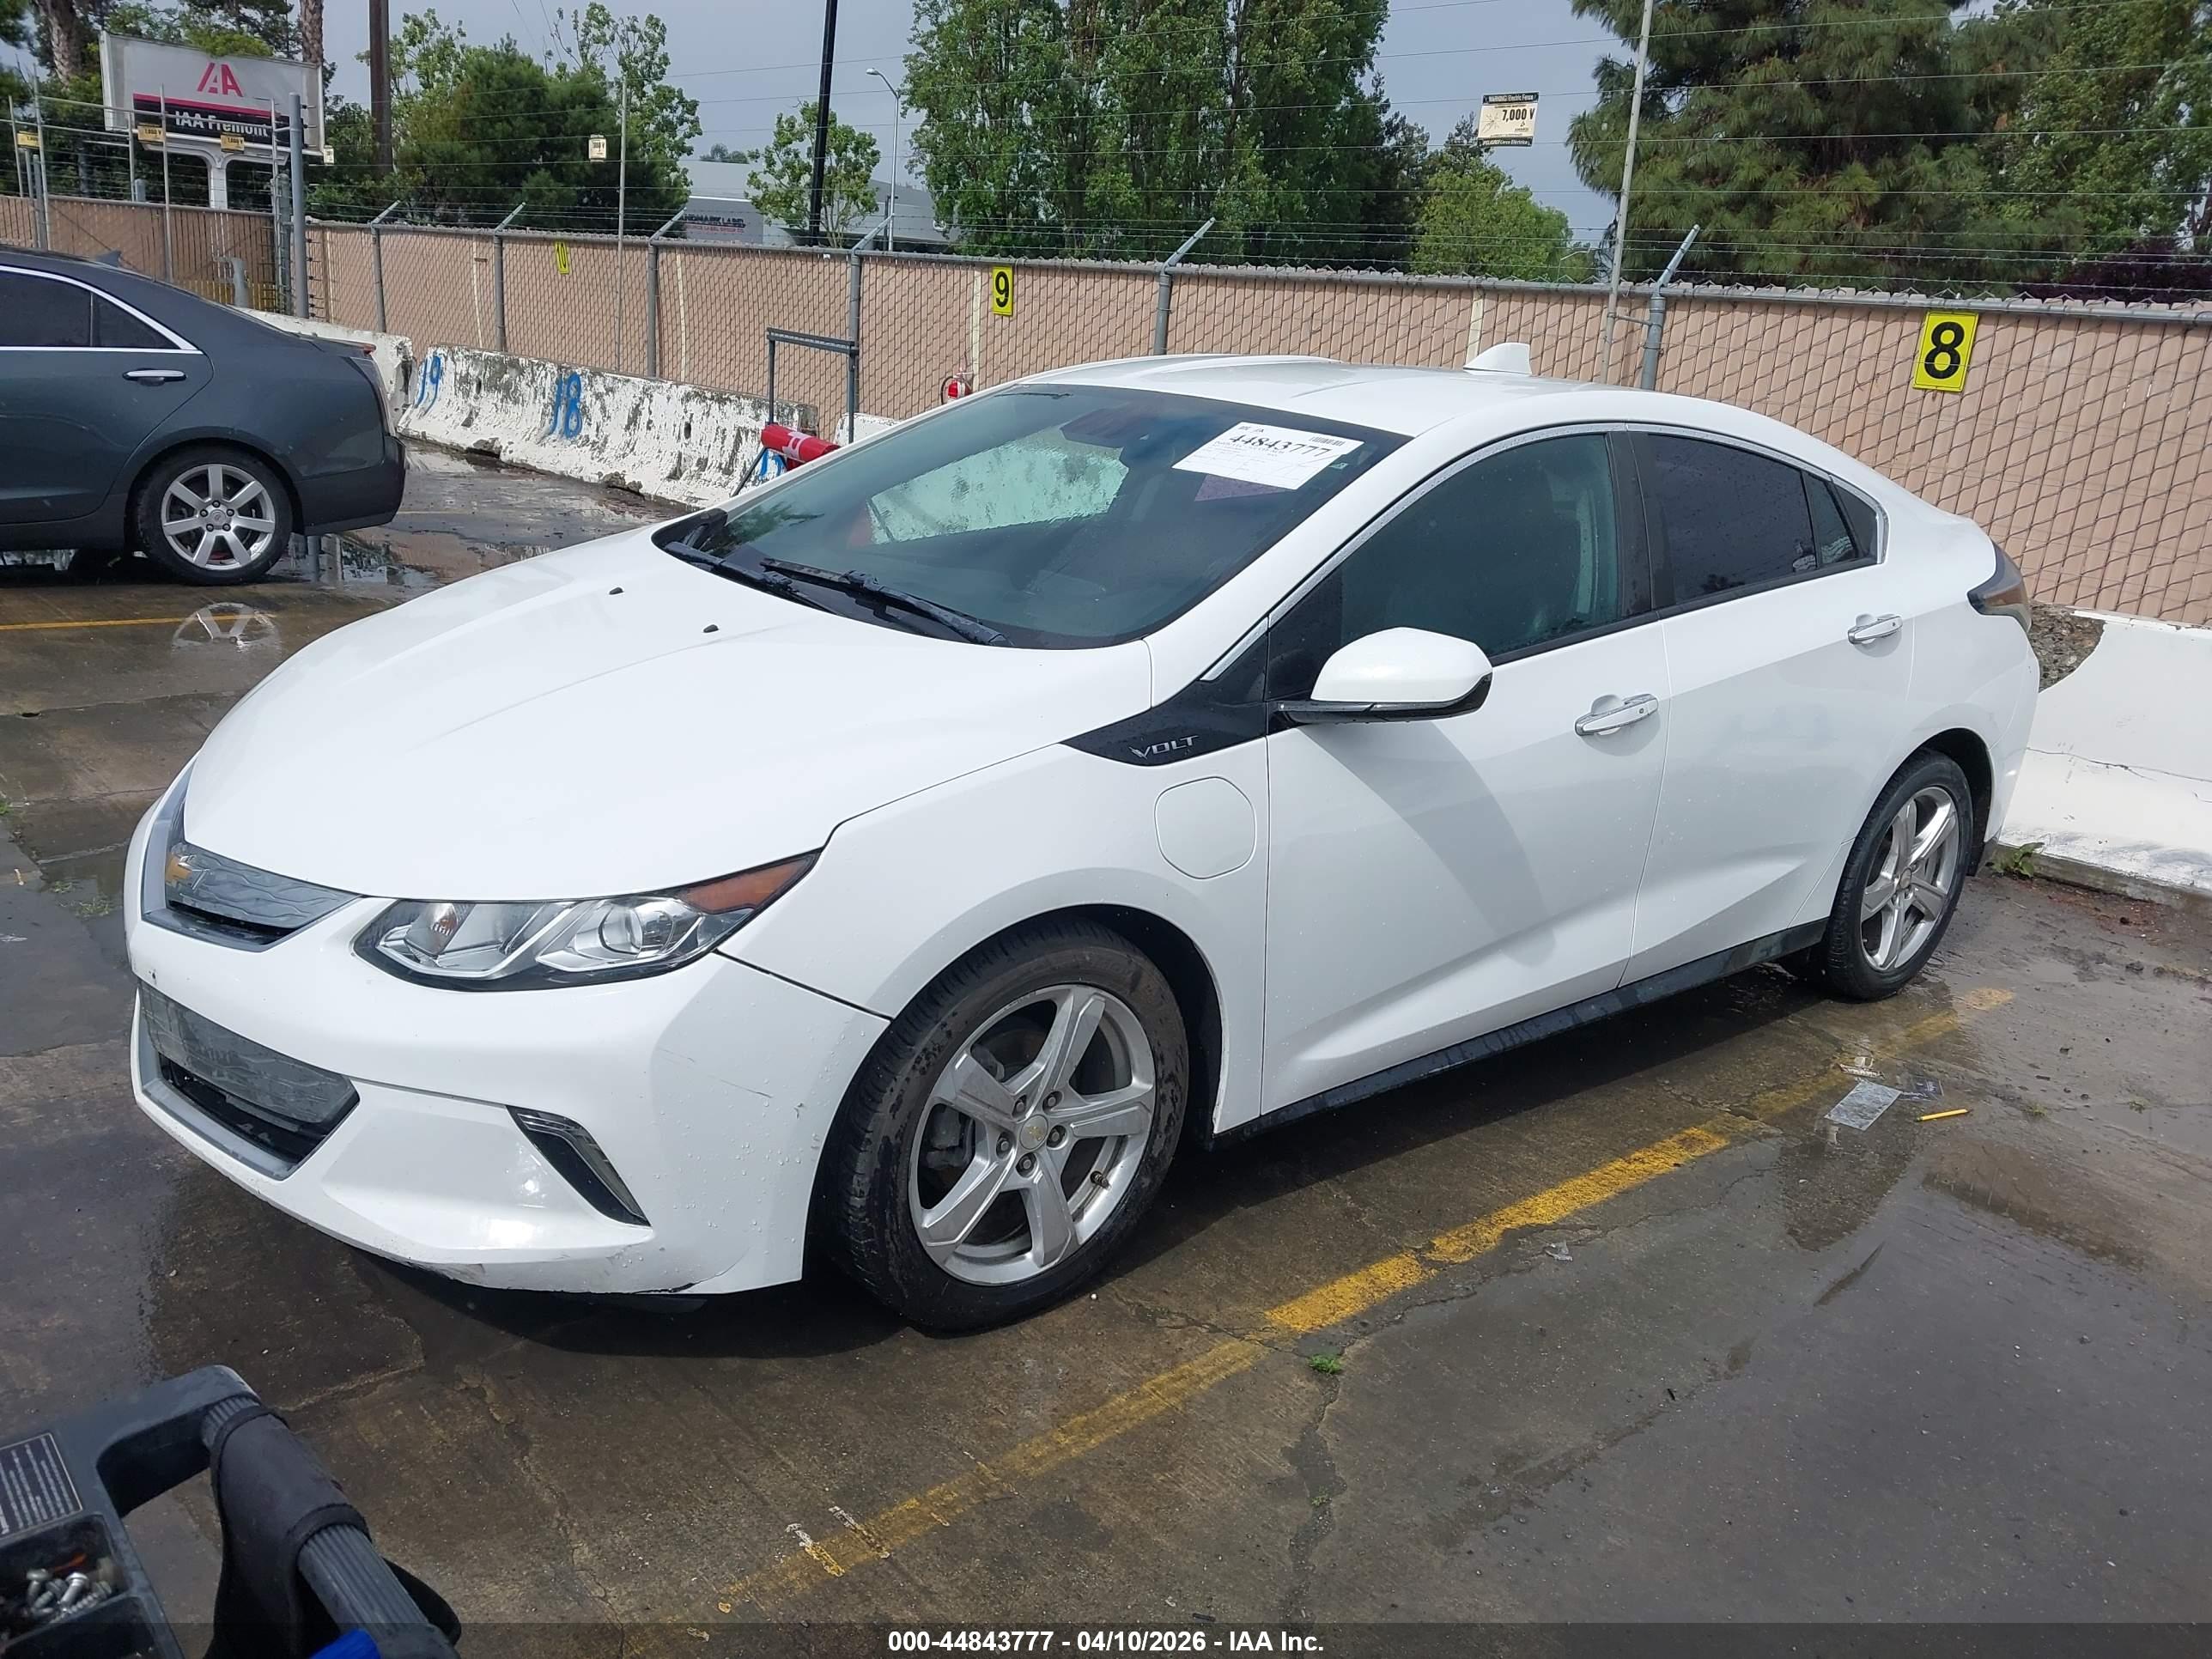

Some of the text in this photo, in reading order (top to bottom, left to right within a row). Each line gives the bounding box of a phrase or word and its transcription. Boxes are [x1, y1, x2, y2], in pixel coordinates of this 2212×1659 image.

[175, 110, 204, 128] IAA
[1502, 108, 1535, 122] 7,000 V
[557, 242, 567, 269] 10
[995, 271, 1009, 307] 9
[1924, 321, 1966, 380] 8
[414, 356, 441, 417] 19
[546, 372, 582, 440] 18
[1229, 434, 1332, 457] 44843777
[1128, 734, 1200, 760] VOLT
